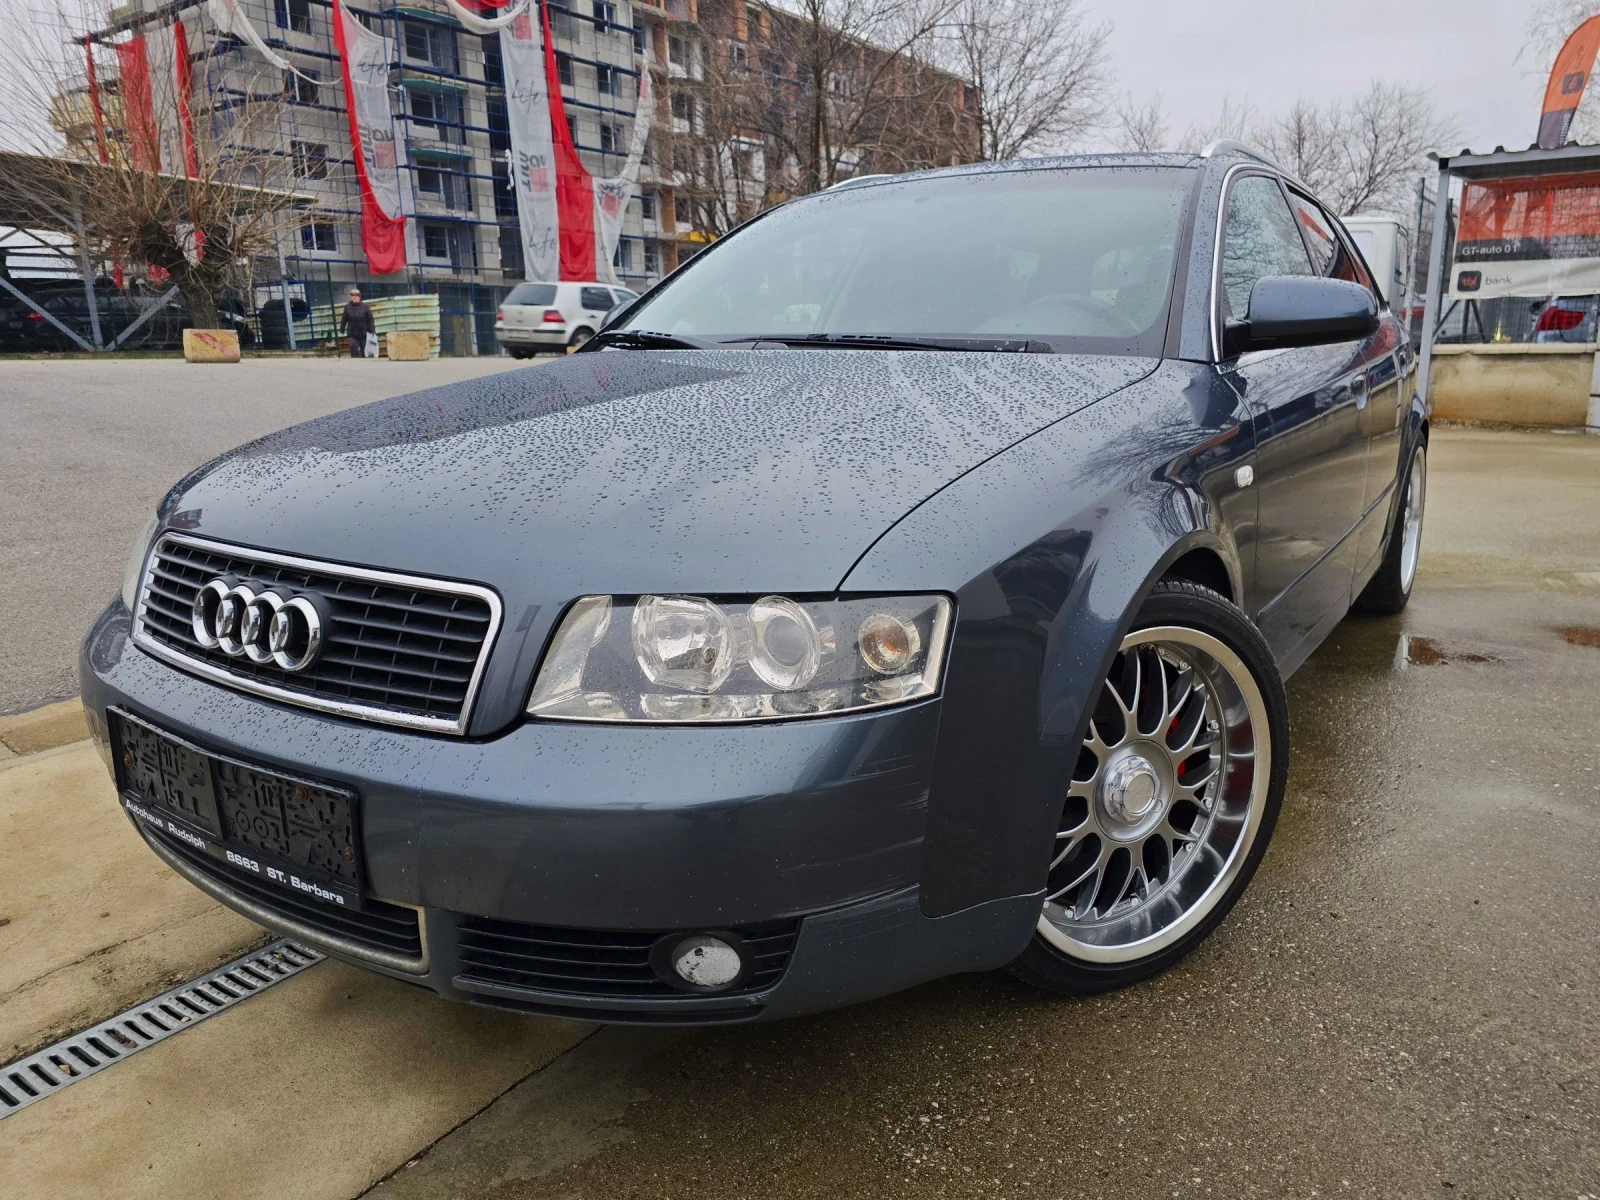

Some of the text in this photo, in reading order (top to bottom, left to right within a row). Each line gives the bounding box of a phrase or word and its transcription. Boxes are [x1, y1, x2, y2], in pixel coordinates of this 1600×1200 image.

[1461, 245, 1502, 255] GT-auto
[1484, 275, 1512, 286] bank
[125, 799, 345, 905] Autohaus Rudolph 8663 ST. Barbara
